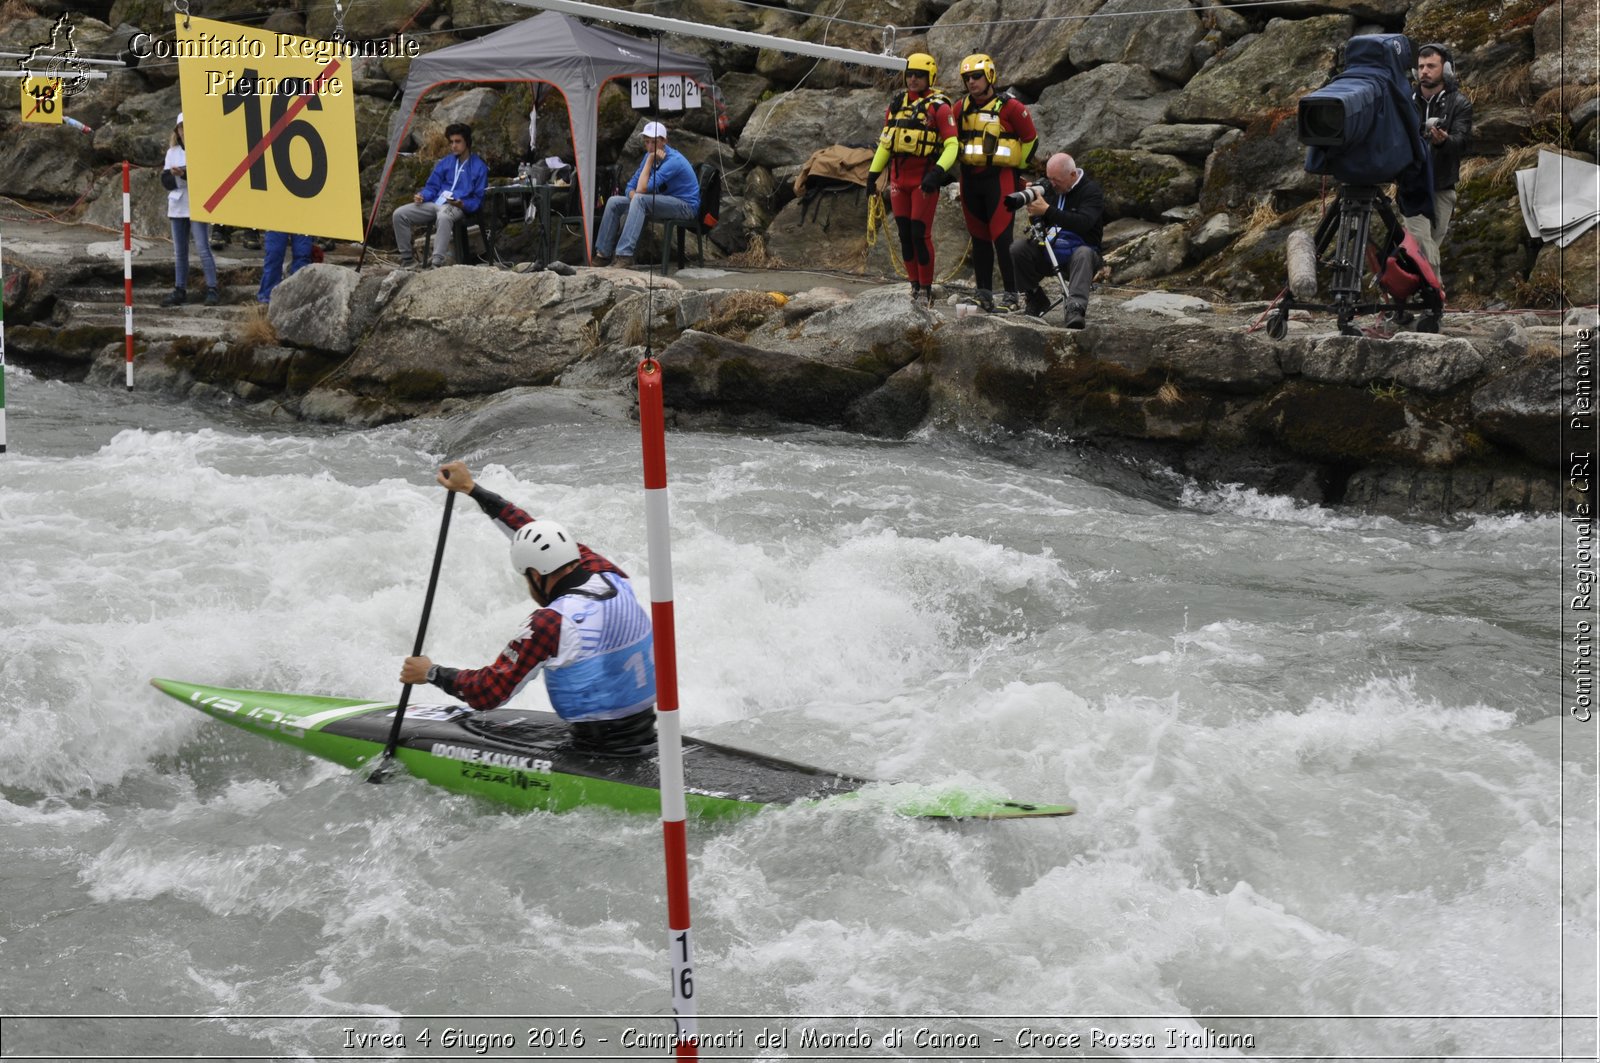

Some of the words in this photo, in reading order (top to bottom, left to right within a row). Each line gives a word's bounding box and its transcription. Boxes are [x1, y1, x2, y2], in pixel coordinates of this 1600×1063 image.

[633, 81, 648, 95] 18
[669, 83, 681, 98] 20
[686, 81, 699, 96] 21
[222, 68, 328, 199] 16
[676, 932, 688, 963] 1
